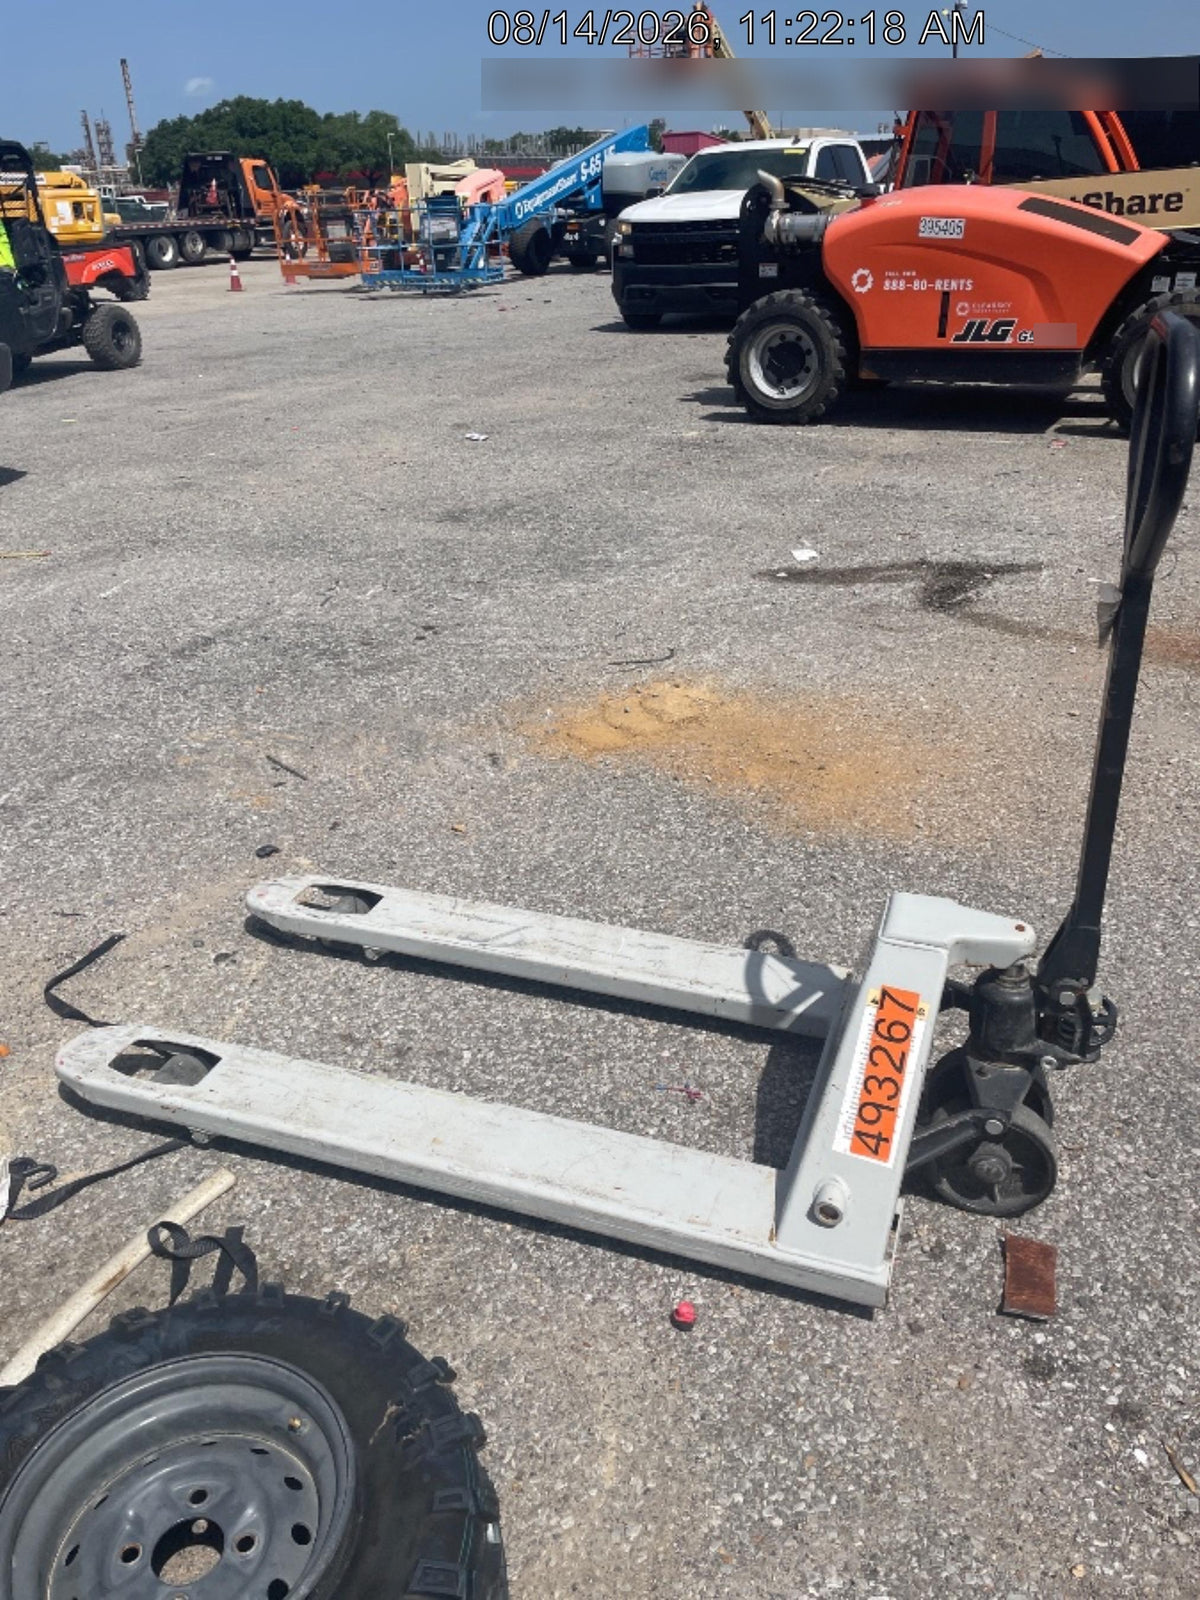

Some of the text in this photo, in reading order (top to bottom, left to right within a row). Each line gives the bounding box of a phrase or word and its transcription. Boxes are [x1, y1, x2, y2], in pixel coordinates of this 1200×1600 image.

[1070, 191, 1184, 216] Share
[883, 278, 974, 291] 888-80-RENTS
[950, 318, 1018, 343] JLG
[854, 988, 915, 1156] 493267
